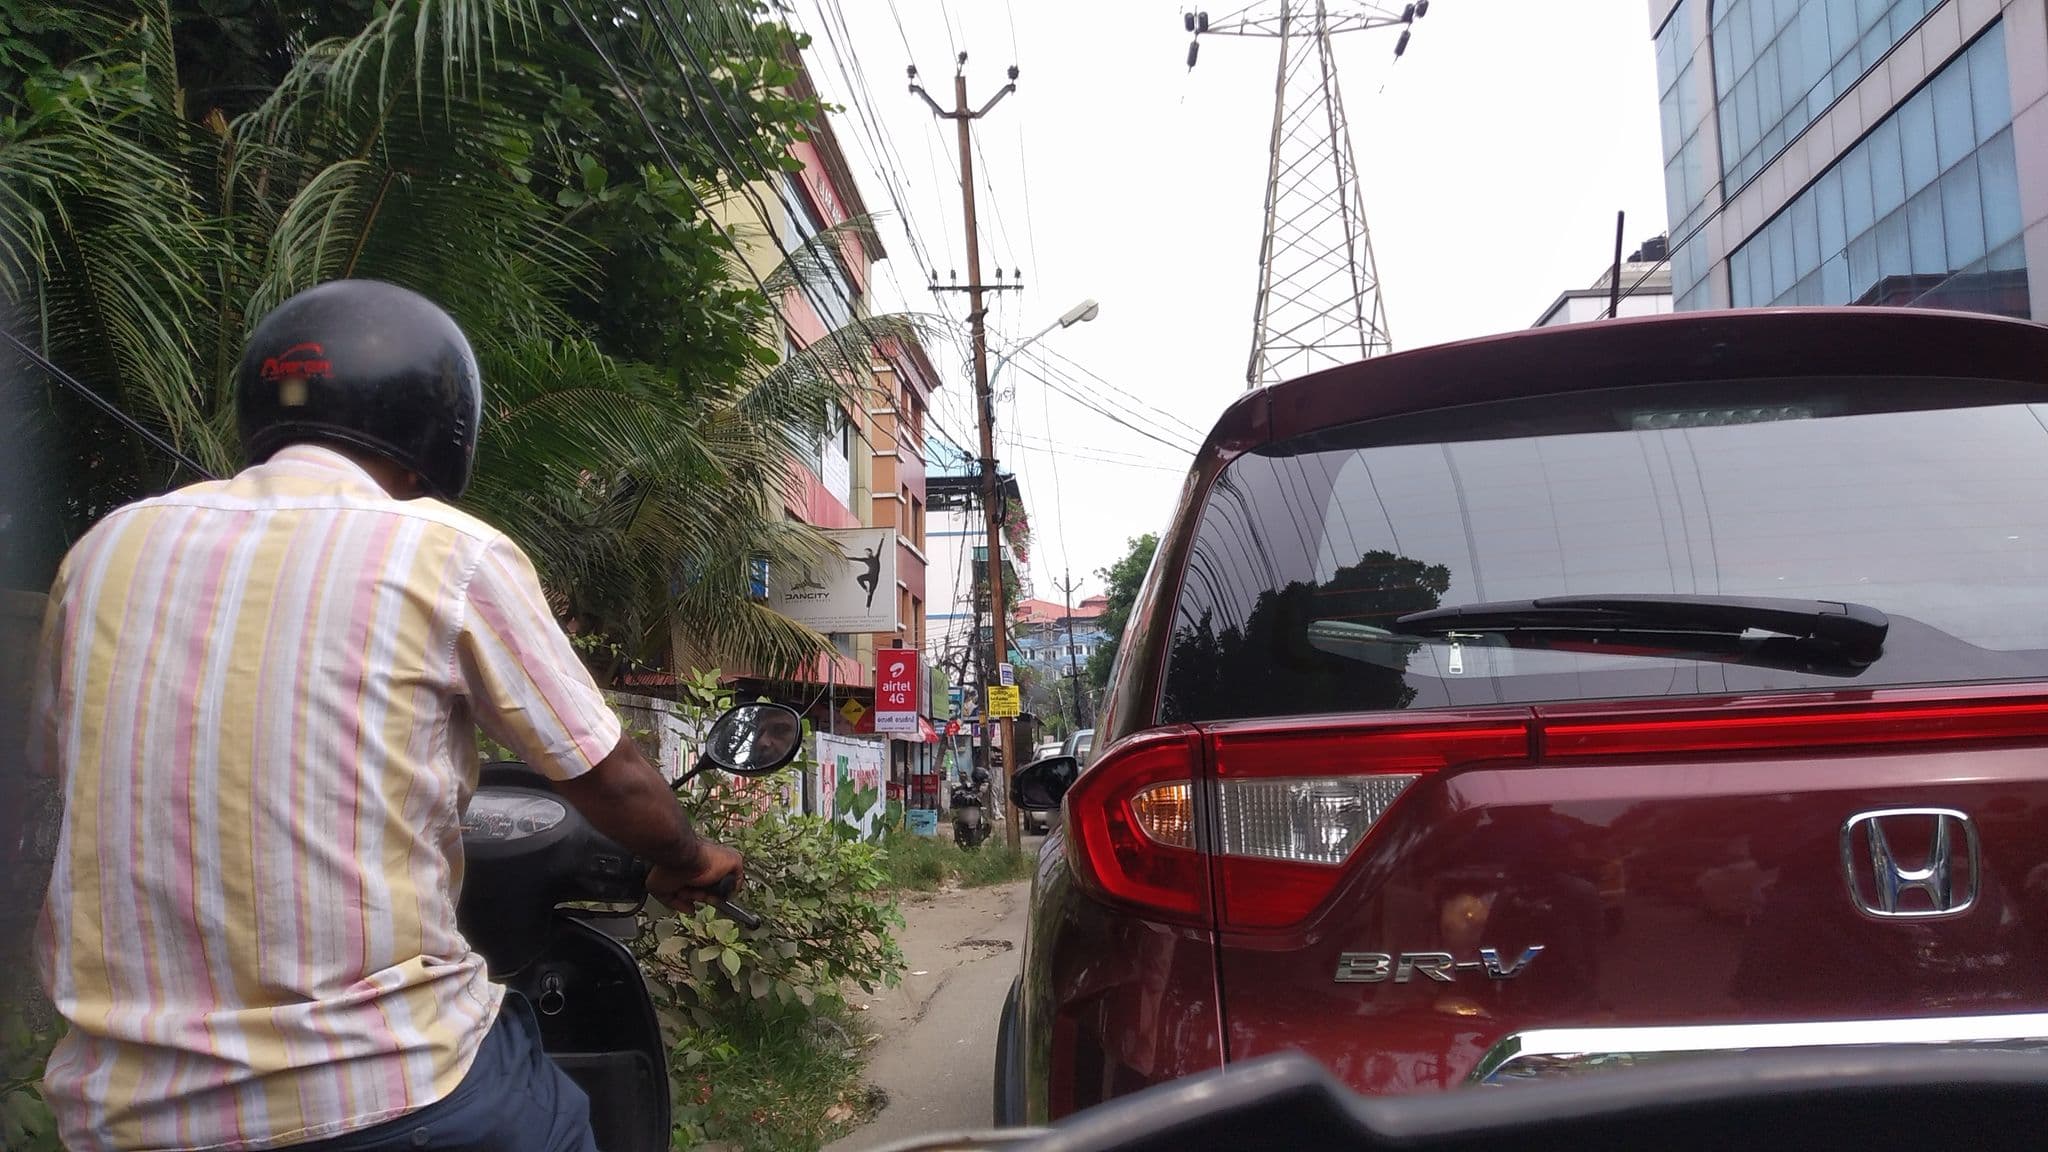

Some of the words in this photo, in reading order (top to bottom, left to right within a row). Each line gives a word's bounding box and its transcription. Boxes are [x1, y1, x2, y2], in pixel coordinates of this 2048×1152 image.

[785, 592, 830, 600] DANCITY
[882, 681, 911, 692] airtel
[889, 693, 905, 704] 4G
[1334, 944, 1546, 984] BR-V
